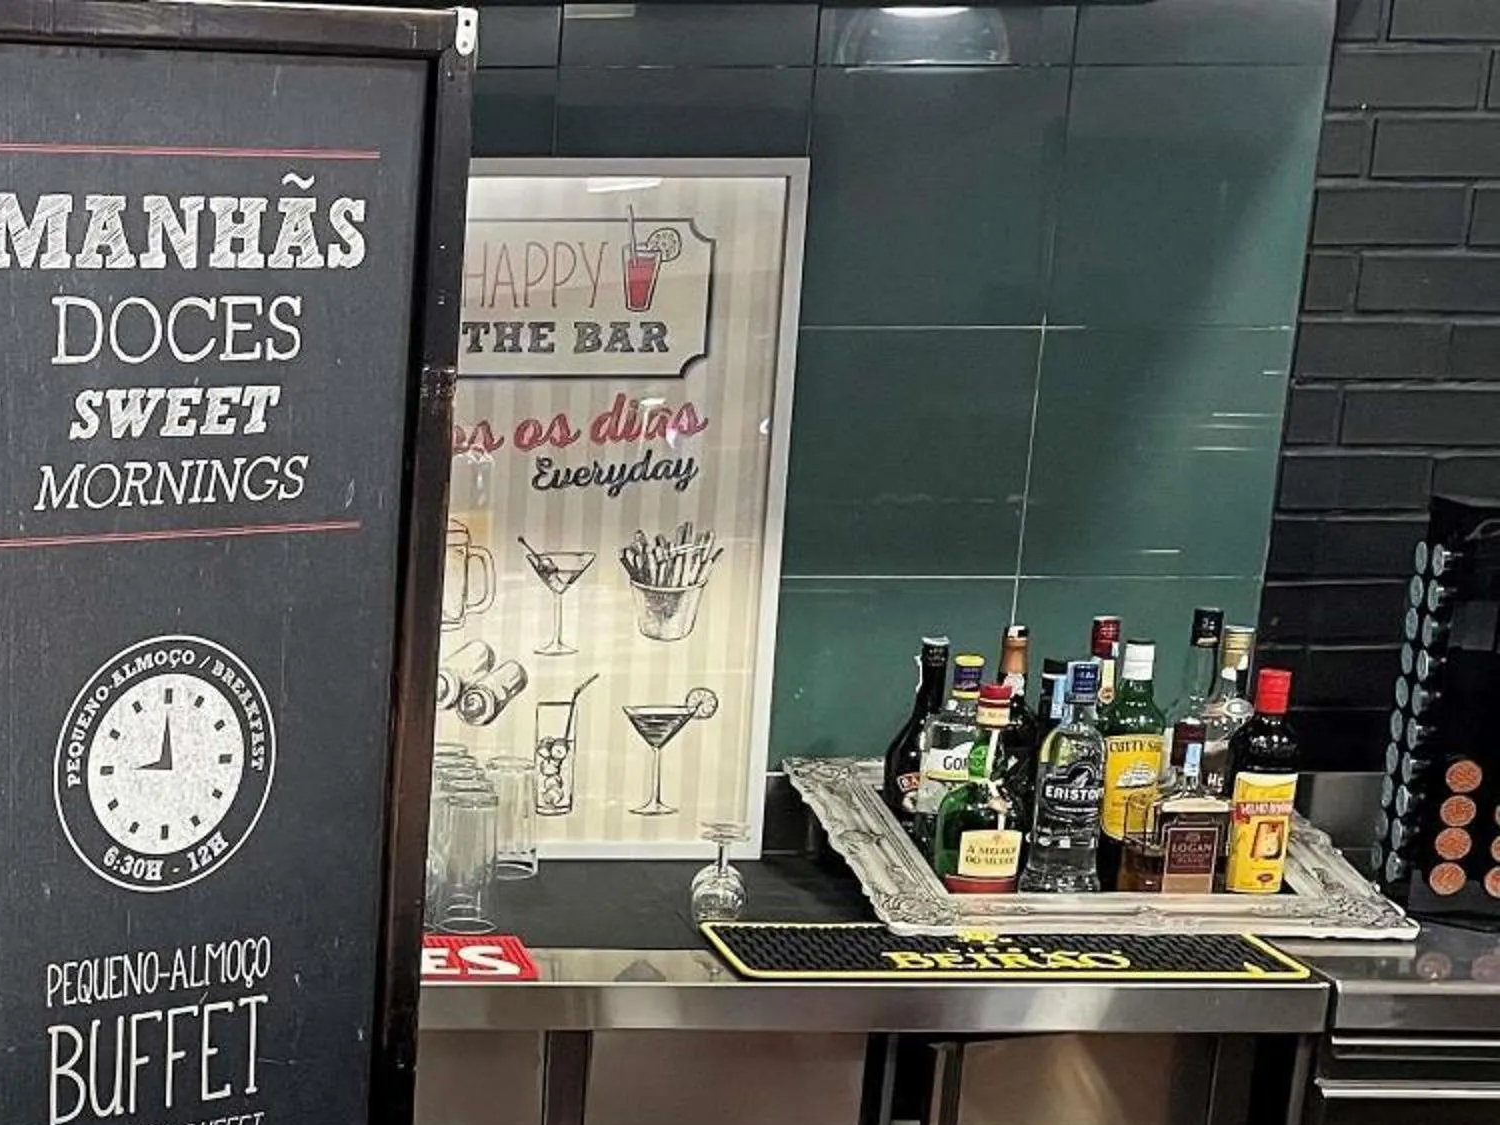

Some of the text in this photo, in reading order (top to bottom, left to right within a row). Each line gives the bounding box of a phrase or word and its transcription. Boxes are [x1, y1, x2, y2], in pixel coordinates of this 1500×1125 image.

[463, 240, 608, 308] HAPPY
[51, 295, 302, 366] DOCES
[462, 321, 671, 354] THE BAR
[69, 385, 281, 441] SWEET
[513, 411, 582, 450] os
[589, 391, 709, 445] dias
[33, 455, 310, 512] MORNINGS
[530, 448, 699, 498] Everyday
[211, 658, 265, 772] BREAKFAST
[102, 846, 164, 881] 6:30H
[186, 831, 230, 873] 12H
[1171, 842, 1212, 853] LOGAN
[47, 935, 271, 1008] PEQUENO-ALMOÇO
[421, 945, 521, 975] ES
